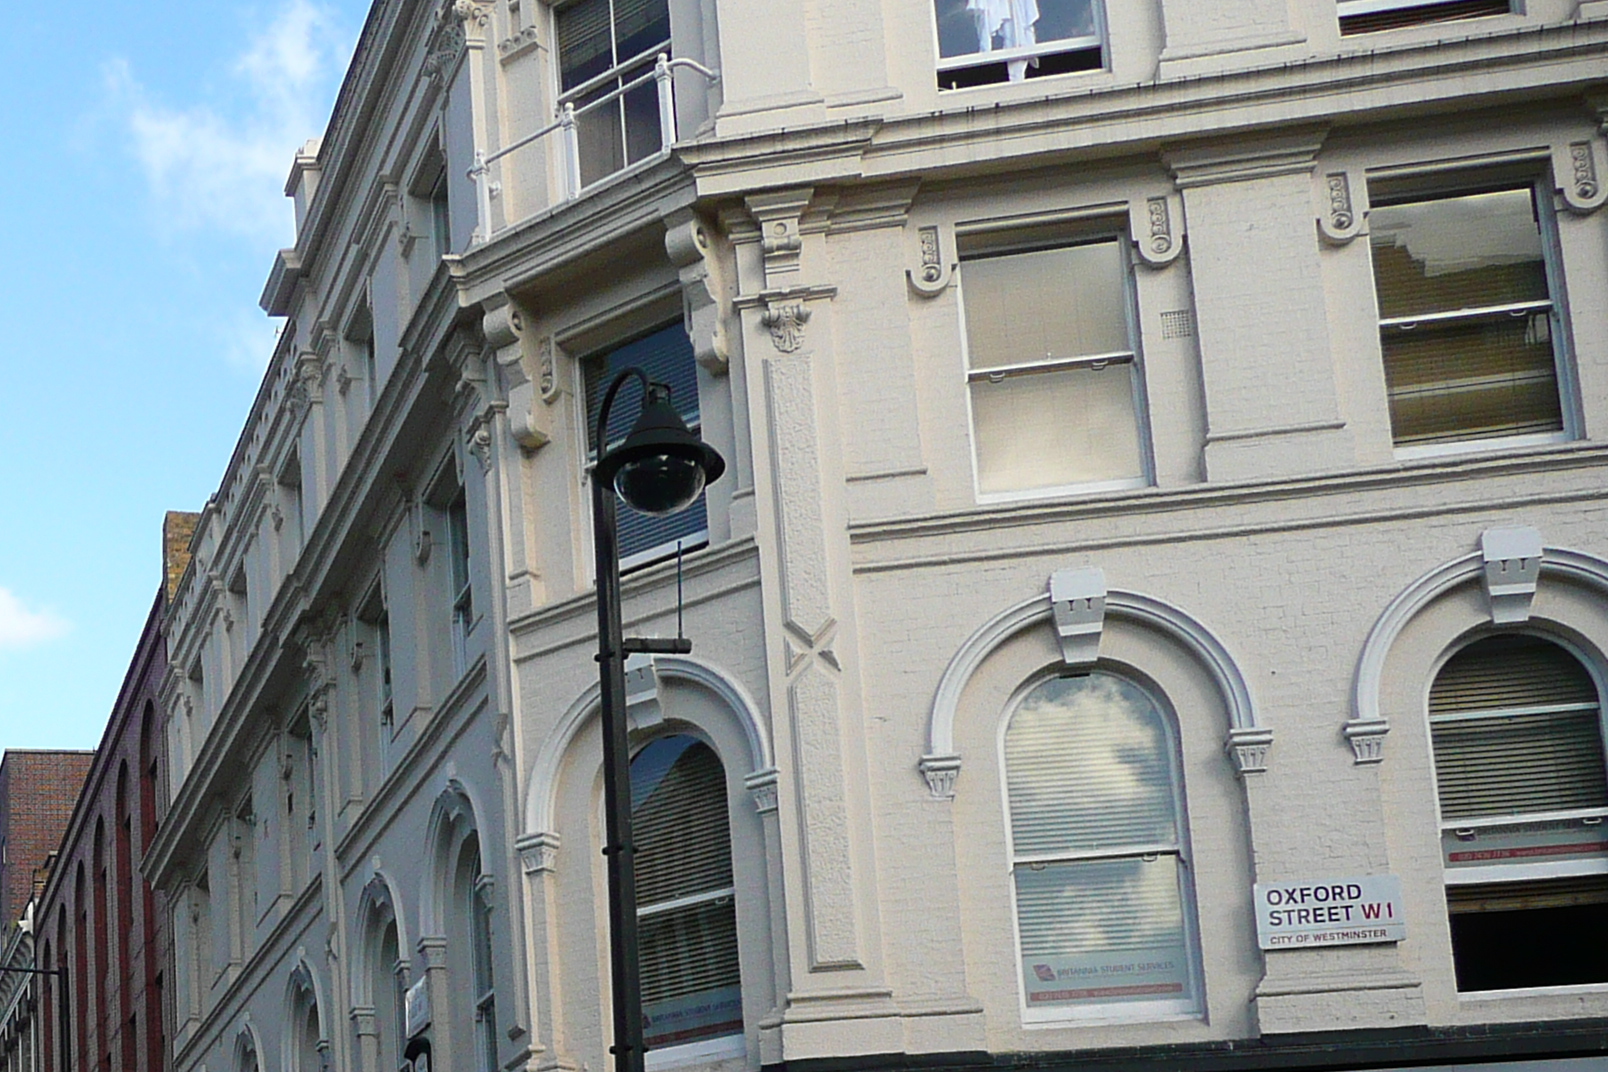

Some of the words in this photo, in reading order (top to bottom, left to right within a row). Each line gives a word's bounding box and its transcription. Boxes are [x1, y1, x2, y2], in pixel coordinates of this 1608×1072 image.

[1267, 884, 1362, 906] OXFORD
[1269, 905, 1354, 926] STREET
[1270, 936, 1293, 945] CITY
[1296, 935, 1310, 943] OF
[1312, 929, 1387, 942] WESTMINSTER
